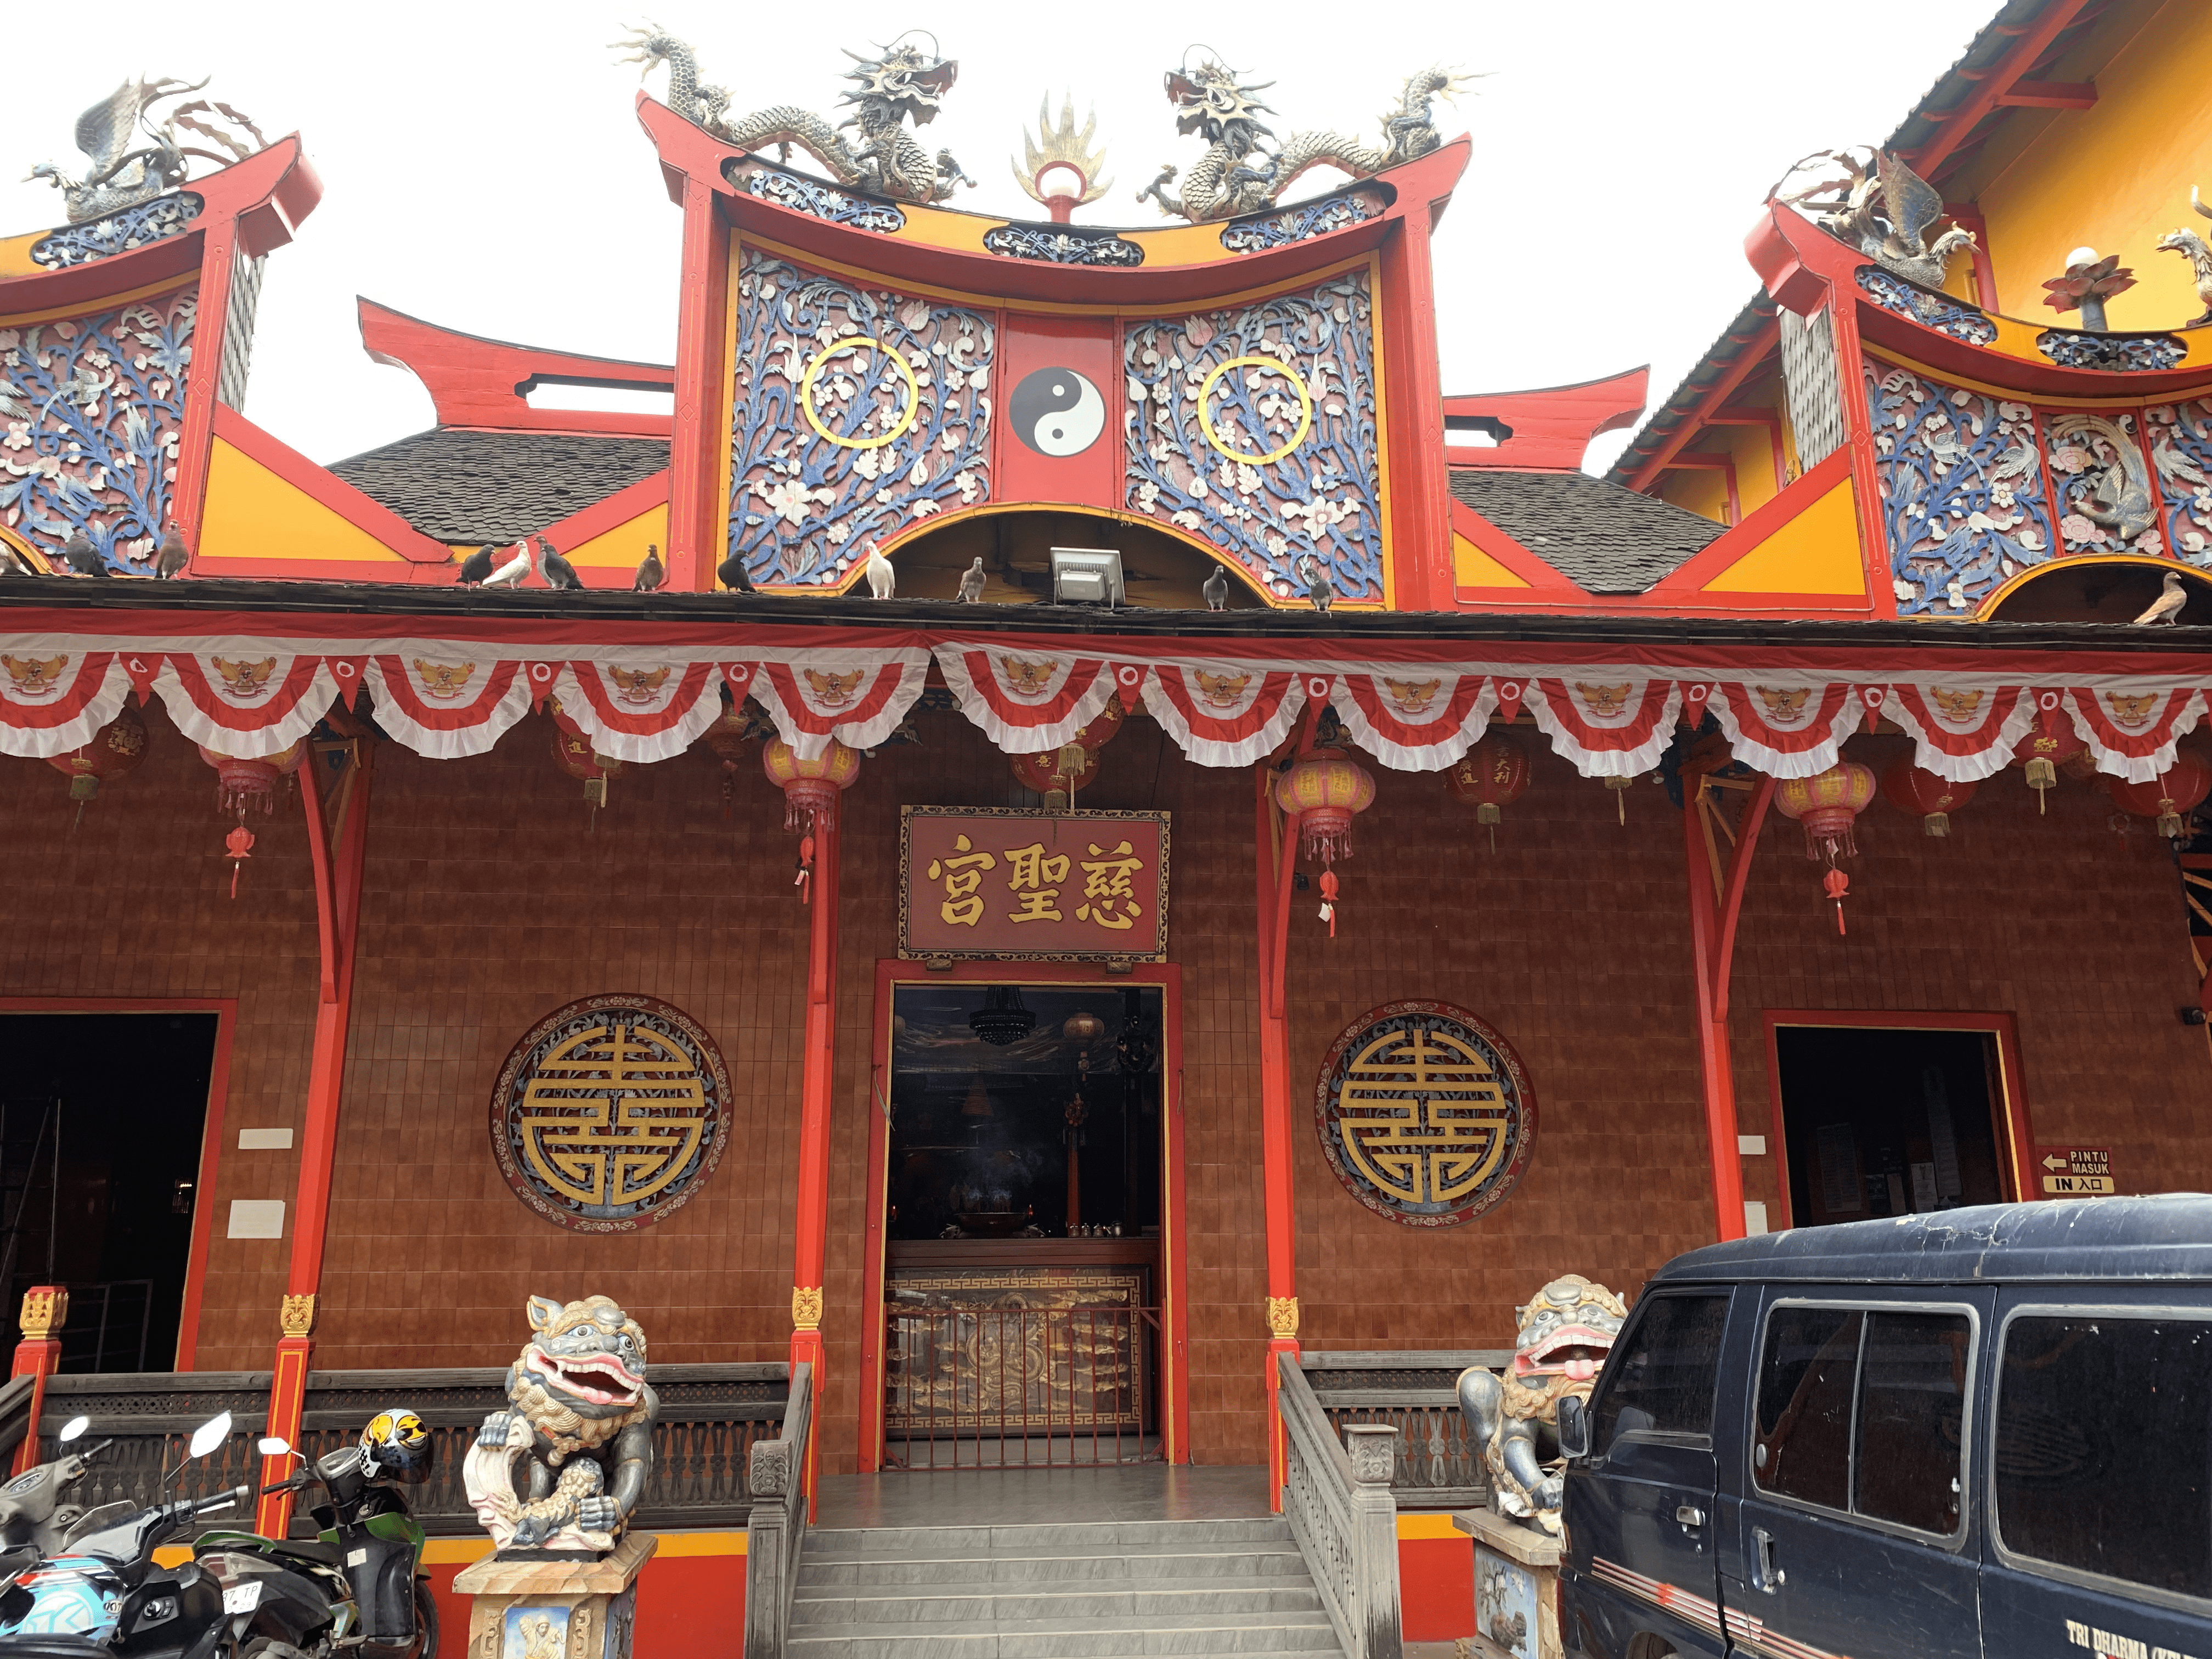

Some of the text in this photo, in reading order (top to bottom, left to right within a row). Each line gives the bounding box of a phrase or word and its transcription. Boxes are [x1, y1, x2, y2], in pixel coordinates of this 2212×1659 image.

[2070, 1151, 2108, 1163] PINTU
[2072, 1163, 2109, 1174] MASUK
[2055, 1178, 2102, 1190] IN 入口
[244, 1585, 258, 1598] TP
[2066, 1618, 2090, 1649] TRI
[2092, 1627, 2148, 1659] DHARMA
